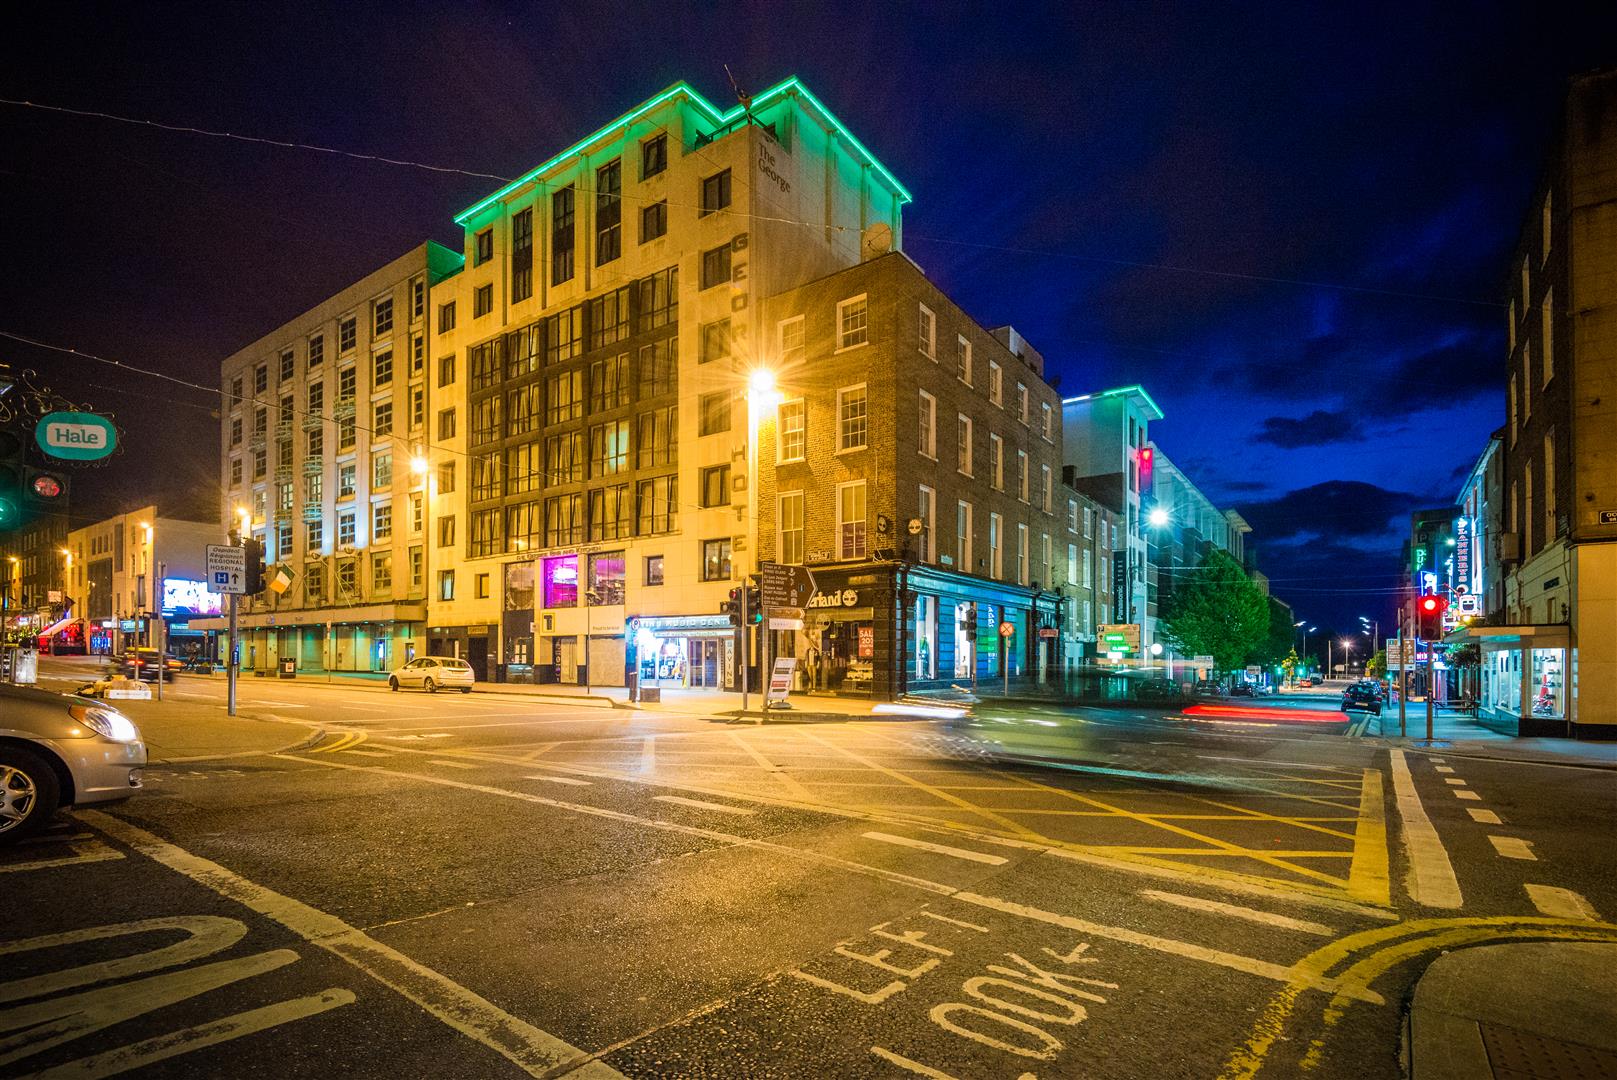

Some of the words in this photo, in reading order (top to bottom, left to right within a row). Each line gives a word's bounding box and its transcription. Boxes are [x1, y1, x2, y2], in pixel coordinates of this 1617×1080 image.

[758, 142, 776, 167] The
[758, 158, 791, 193] George
[55, 427, 99, 444] Hale
[731, 444, 748, 581] HOTEL
[210, 564, 243, 572] HOSPITAL
[217, 573, 226, 582] H
[666, 617, 696, 627] MUSIC
[699, 617, 729, 626] CENT
[790, 903, 989, 1004] LEFT
